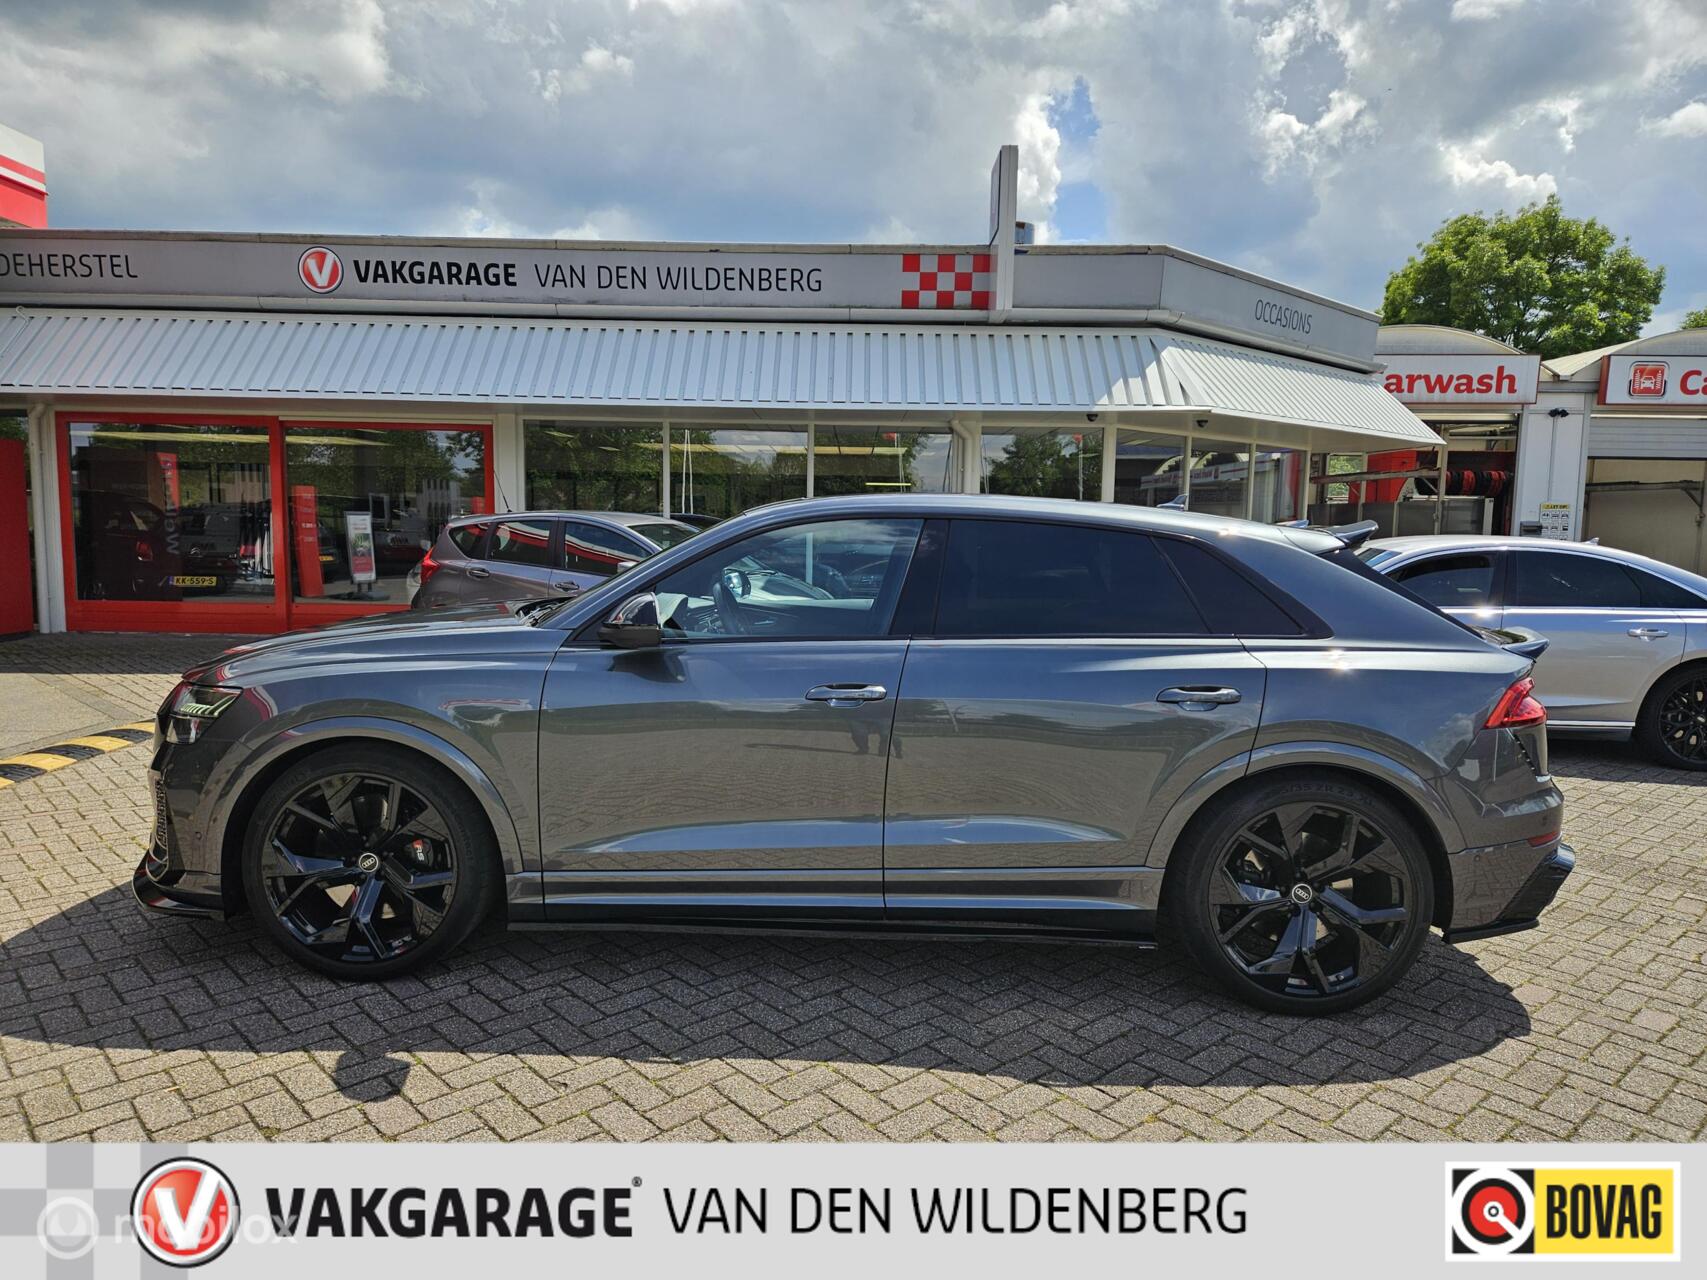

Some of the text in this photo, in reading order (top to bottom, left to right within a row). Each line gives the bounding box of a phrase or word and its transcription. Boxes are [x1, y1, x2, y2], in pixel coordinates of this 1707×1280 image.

[353, 260, 517, 286] VAKGARAGE
[534, 264, 585, 288] VAN
[597, 265, 647, 289] DEN
[656, 266, 822, 291] WILDENBERG
[1255, 299, 1312, 334] OCCASIONS
[1384, 365, 1517, 394] arwash
[175, 577, 214, 585] KK-559-S
